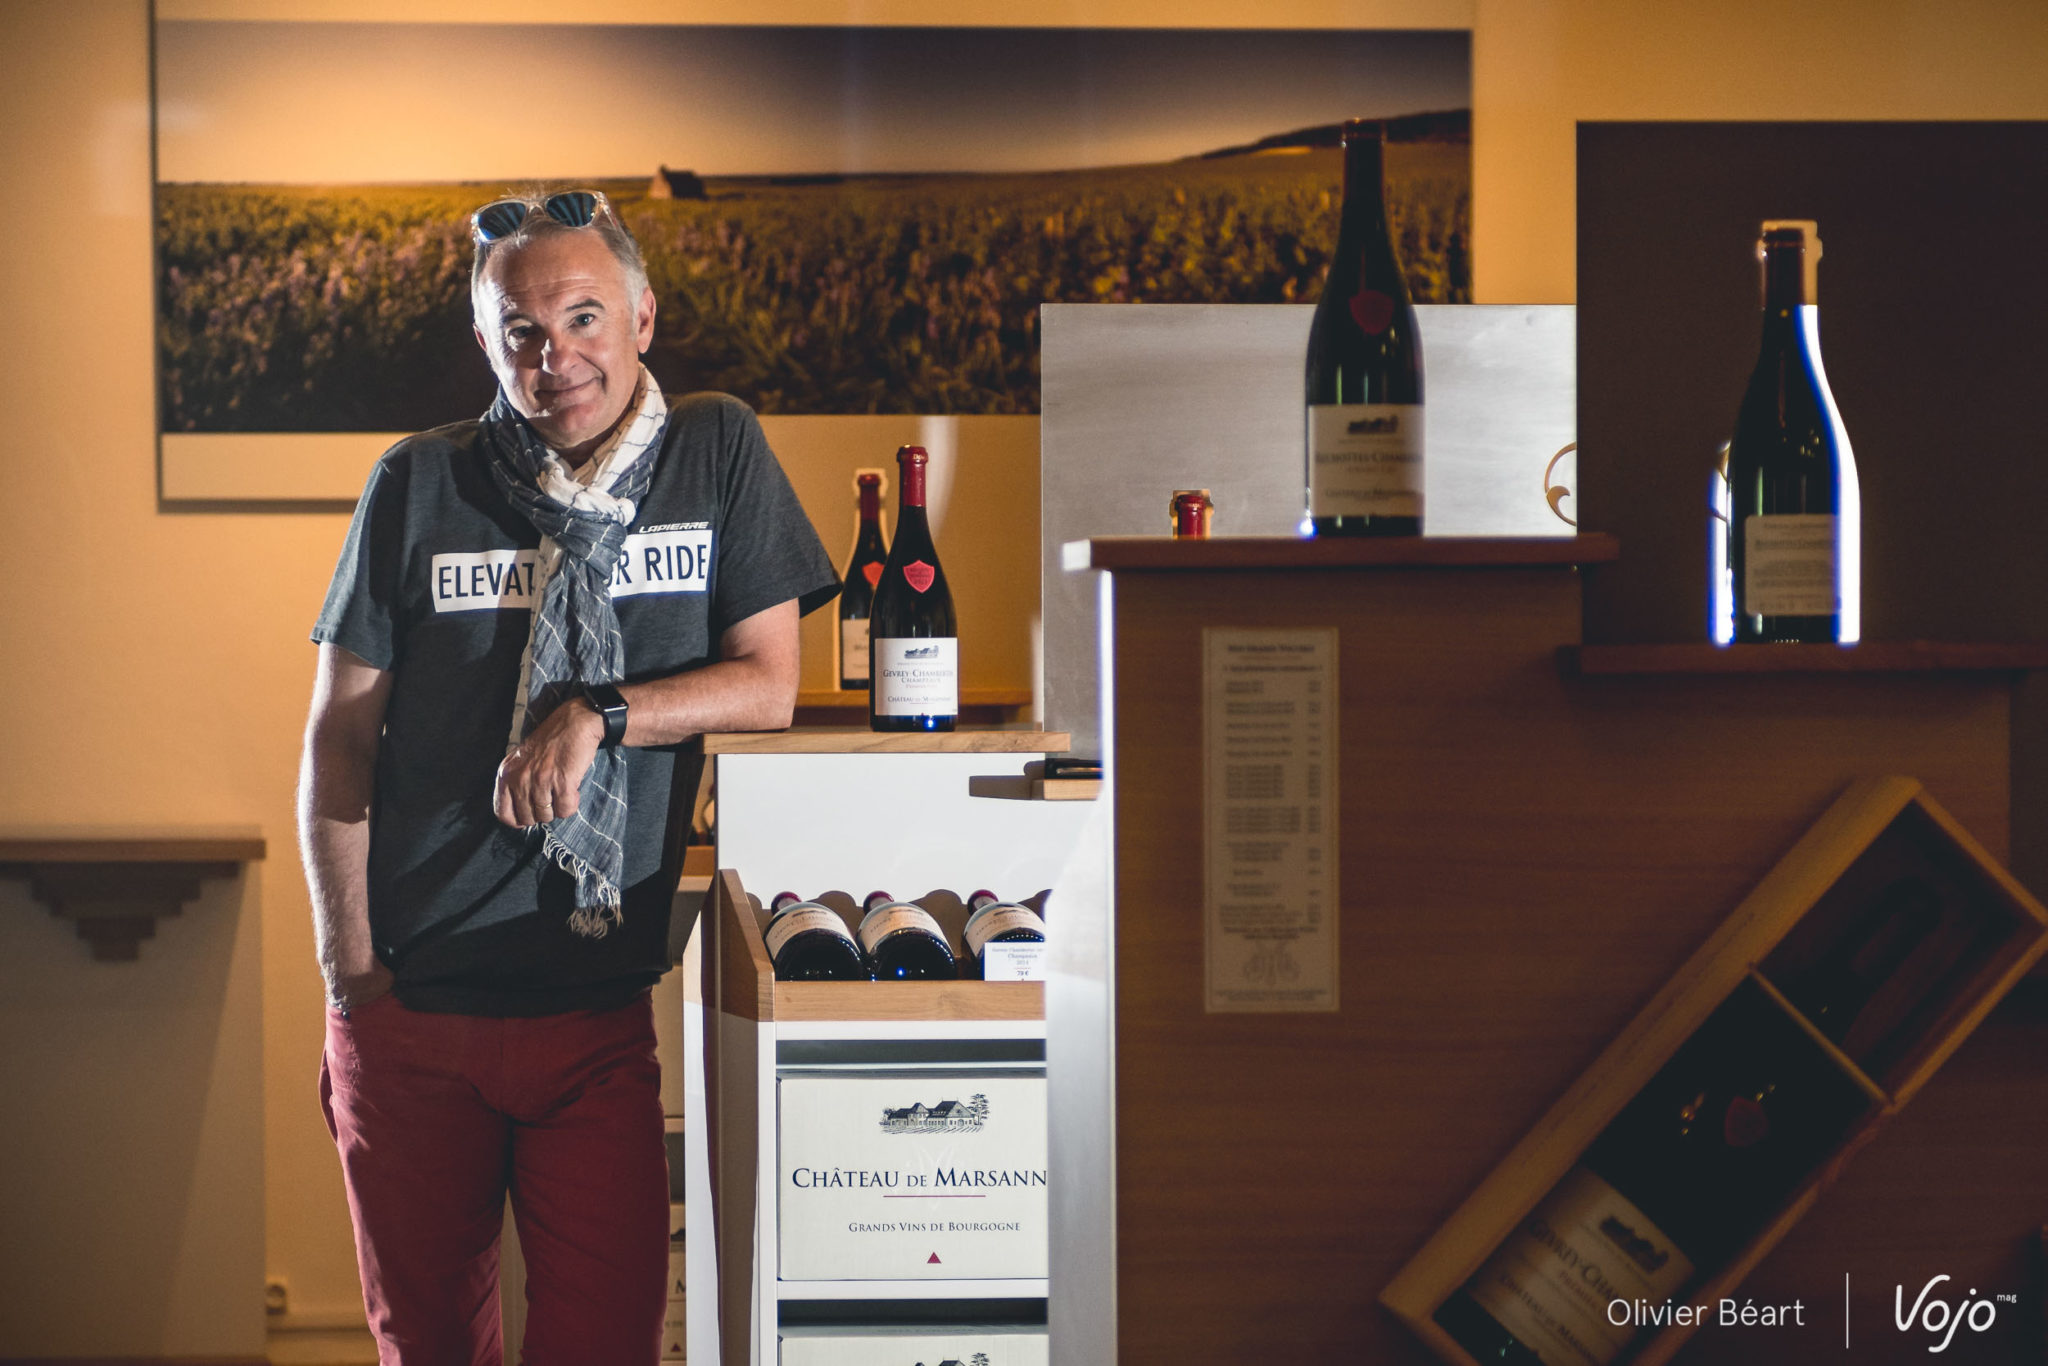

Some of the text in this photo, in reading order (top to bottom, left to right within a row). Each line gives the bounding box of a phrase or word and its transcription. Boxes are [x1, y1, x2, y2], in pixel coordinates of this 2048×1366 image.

[639, 521, 710, 534] LAPIERRE
[644, 544, 708, 582] RIDE
[791, 1166, 899, 1188] CHÂTEAU
[906, 1174, 928, 1188] DE
[848, 1221, 1022, 1233] GRANDS VINS DE BOURGOGNE
